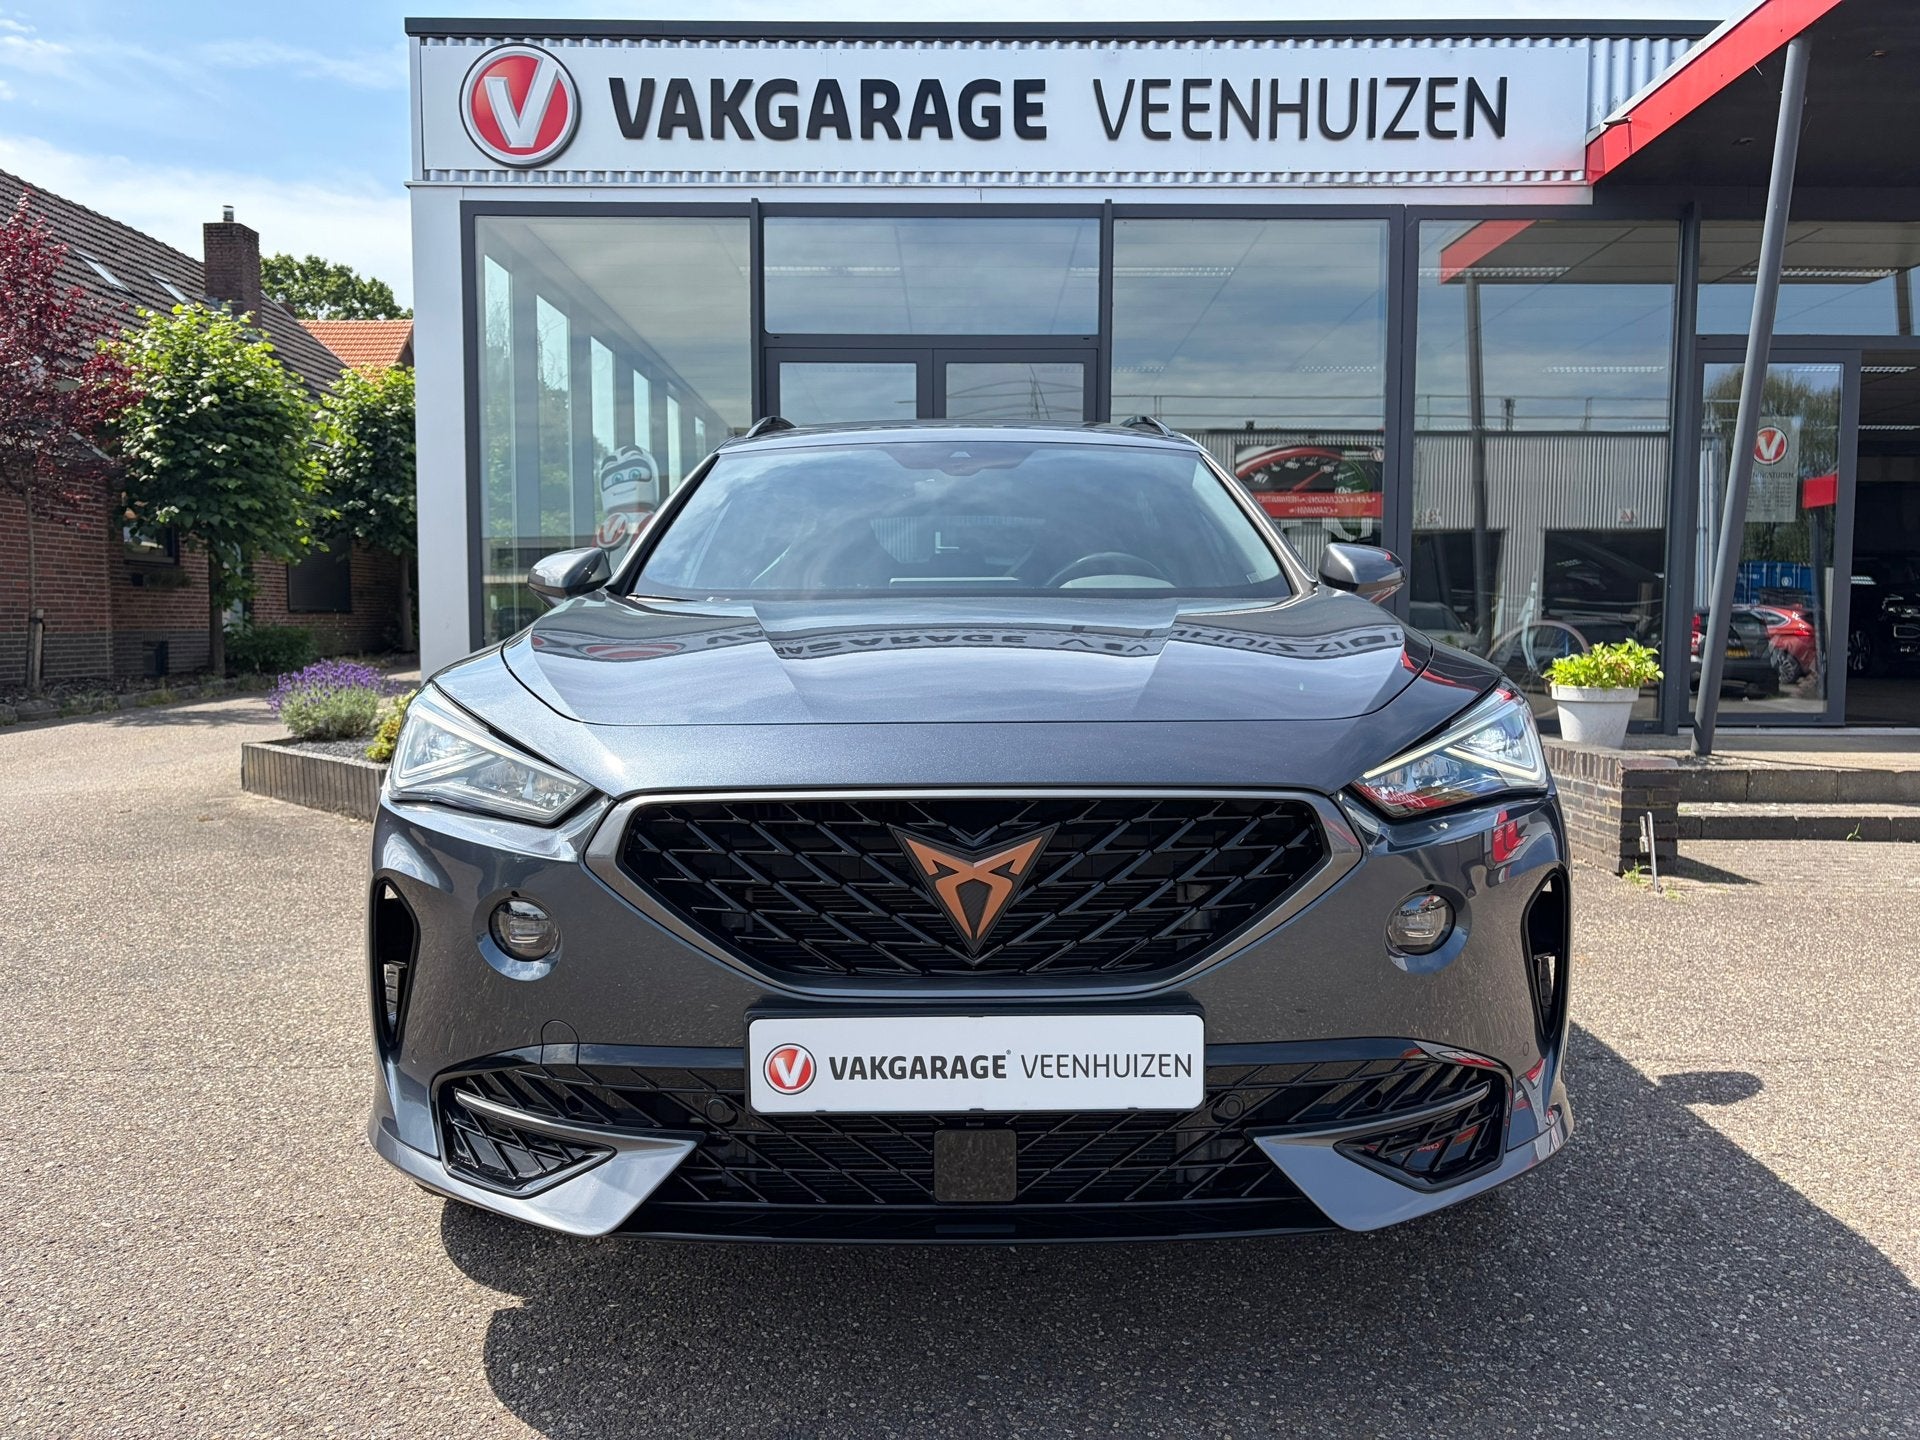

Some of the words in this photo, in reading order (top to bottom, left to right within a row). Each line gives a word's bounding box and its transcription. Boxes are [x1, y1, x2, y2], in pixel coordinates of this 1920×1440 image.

[483, 55, 560, 149] V
[608, 77, 1048, 141] VAKGARAGE
[1093, 76, 1508, 141] VEENHUIZEN
[1020, 1053, 1192, 1079] VEENHUIZEN
